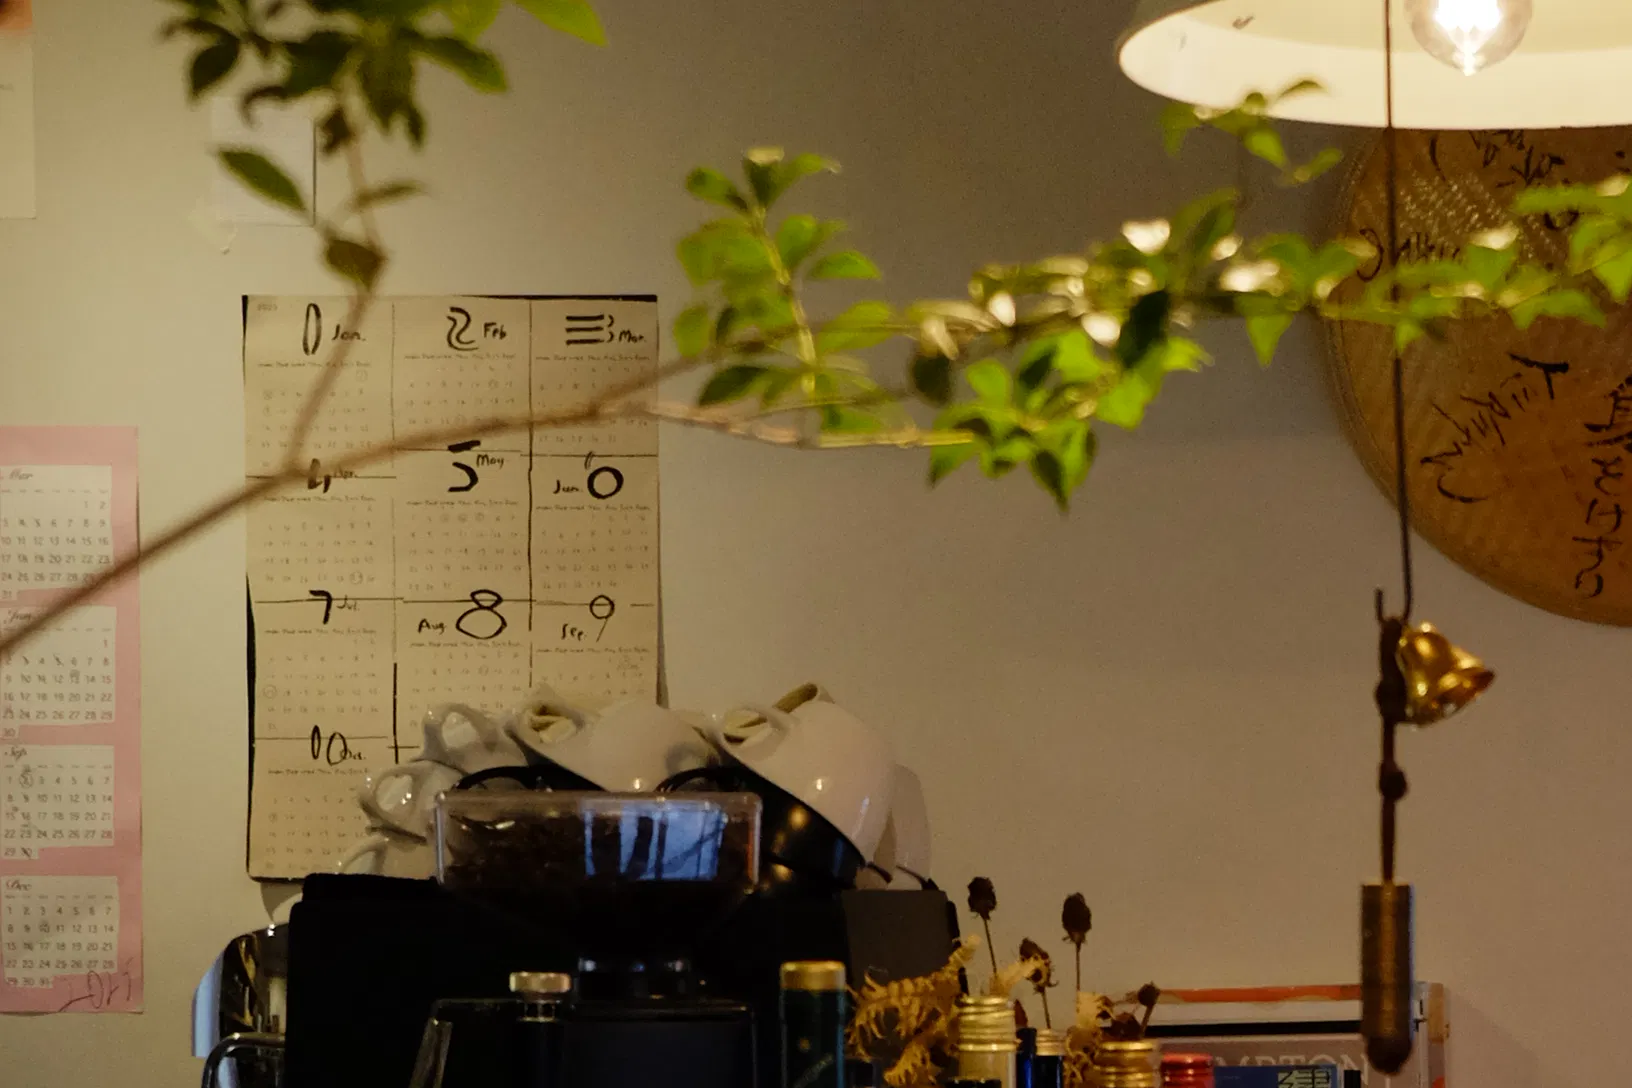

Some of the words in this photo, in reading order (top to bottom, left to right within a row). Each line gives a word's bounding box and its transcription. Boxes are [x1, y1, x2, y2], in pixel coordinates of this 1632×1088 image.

[483, 321, 508, 340] Feb
[476, 454, 504, 470] May
[308, 589, 333, 626] 7
[455, 588, 508, 640] 8
